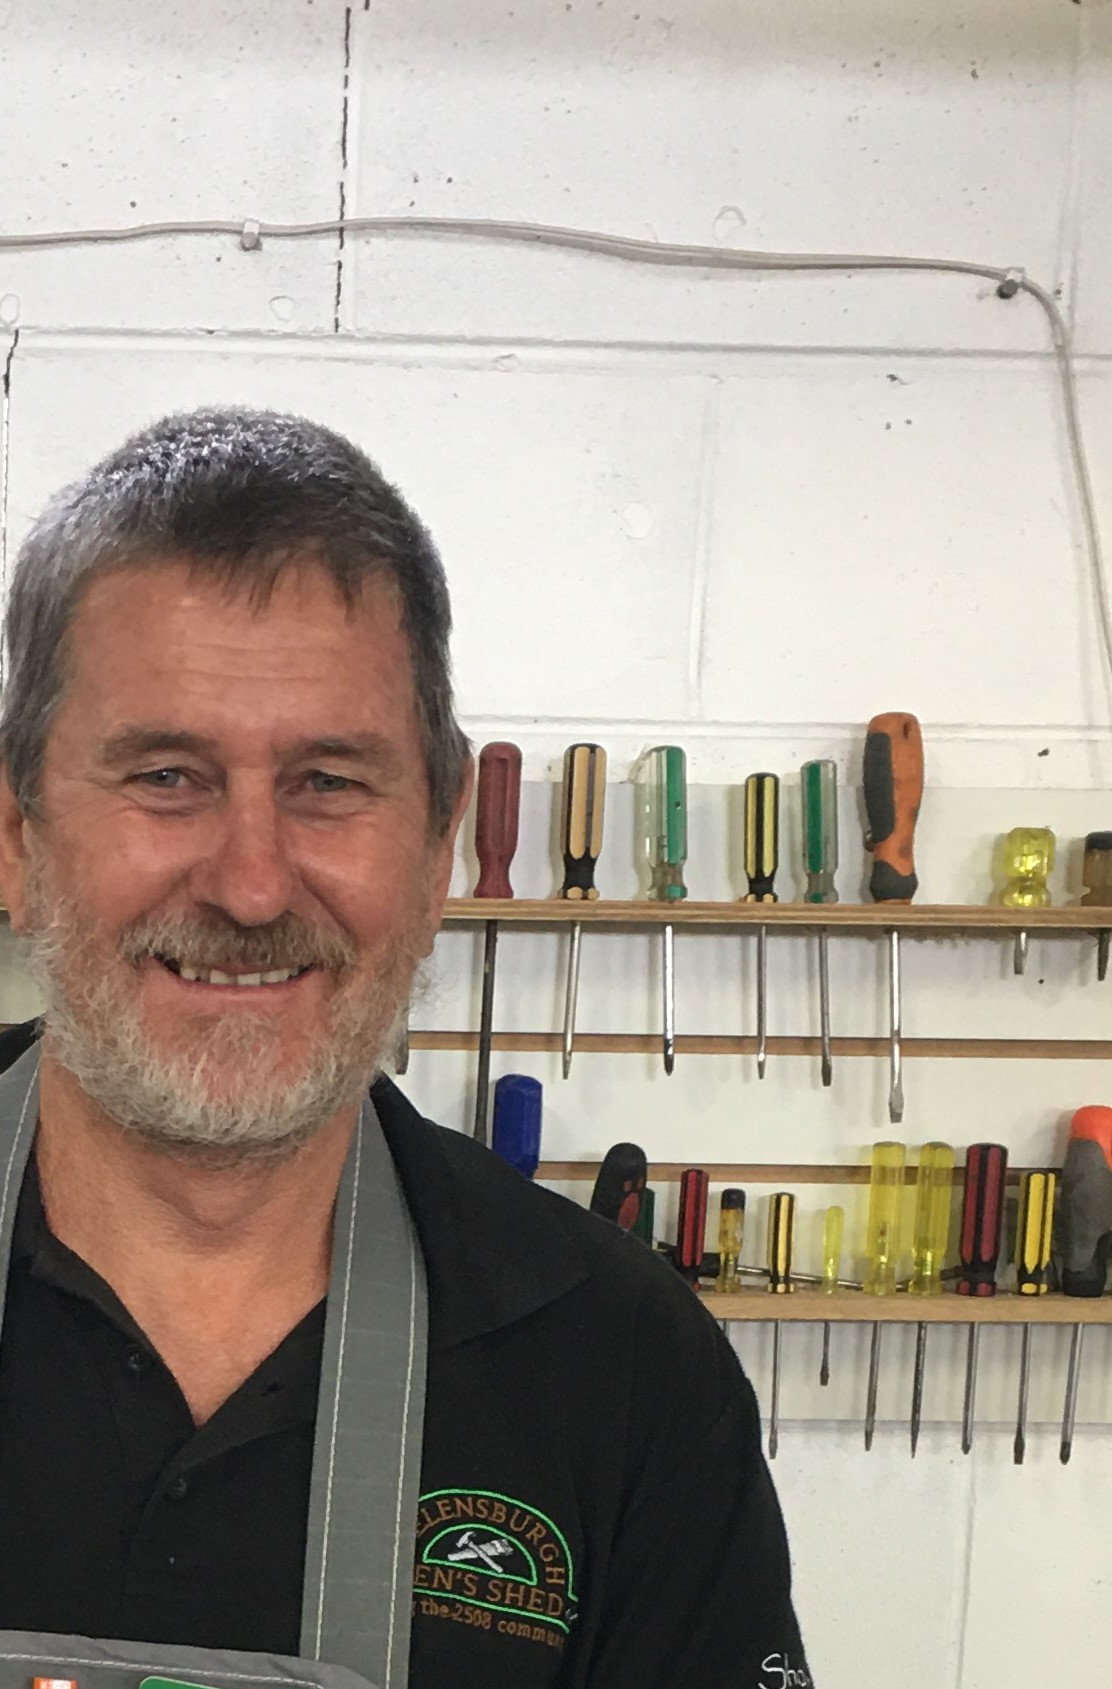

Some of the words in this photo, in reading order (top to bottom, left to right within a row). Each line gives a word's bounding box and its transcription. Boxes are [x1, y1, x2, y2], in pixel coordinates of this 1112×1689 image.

[416, 1496, 565, 1585] LENSBURGH
[413, 1565, 479, 1597] EN'S
[486, 1579, 564, 1616] SHED
[420, 1599, 449, 1618] the
[451, 1603, 492, 1629] 2508
[497, 1620, 564, 1648] commu
